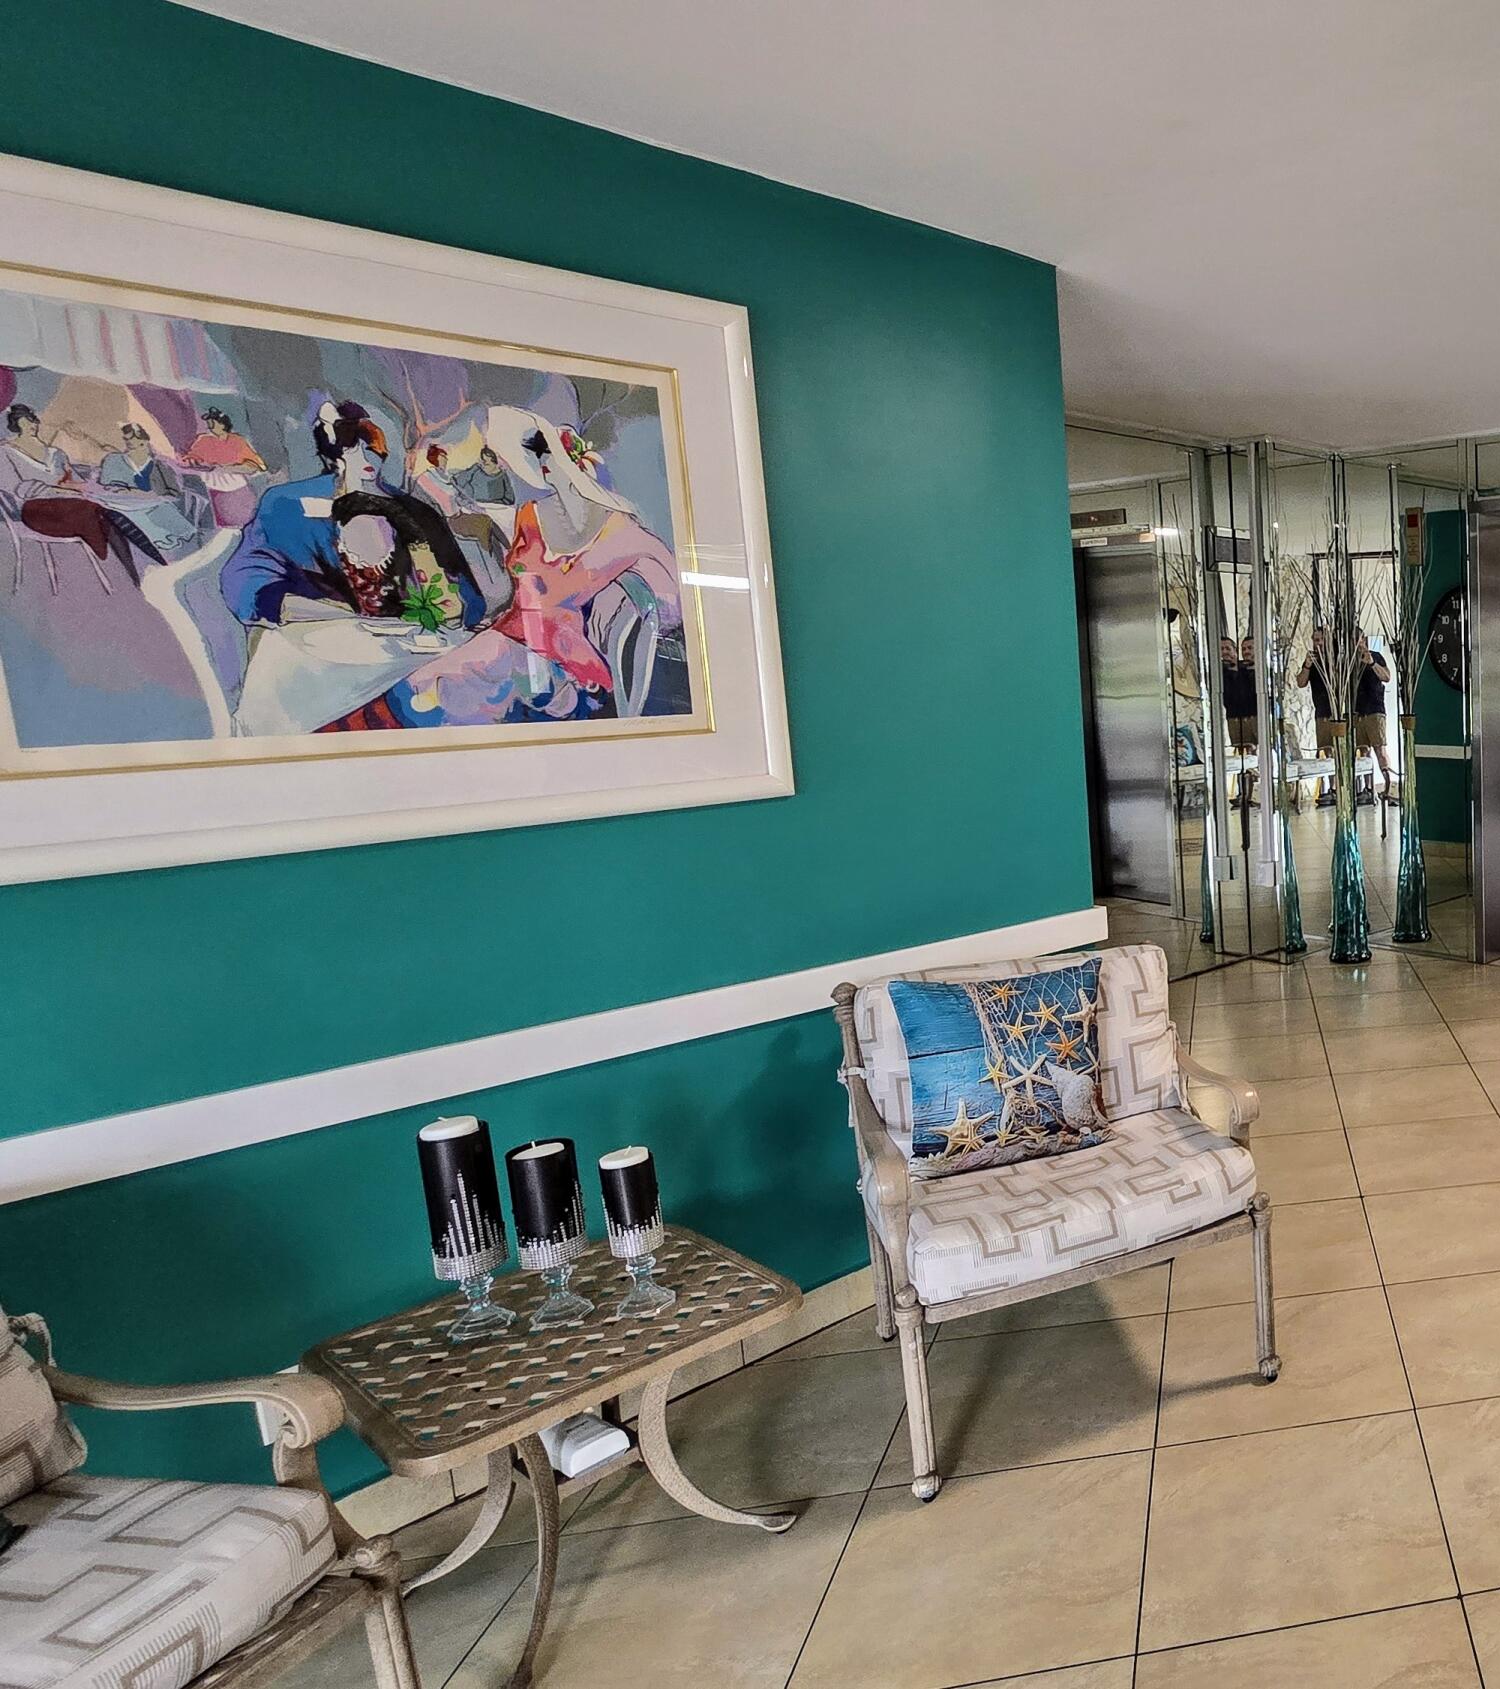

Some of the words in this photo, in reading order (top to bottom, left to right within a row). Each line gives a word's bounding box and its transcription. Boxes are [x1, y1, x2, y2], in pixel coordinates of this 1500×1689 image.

[1452, 600, 1459, 609] 11
[1441, 616, 1450, 624] 10
[1437, 634, 1444, 643] 9
[1441, 653, 1448, 663] 8
[1452, 667, 1459, 677] 7
